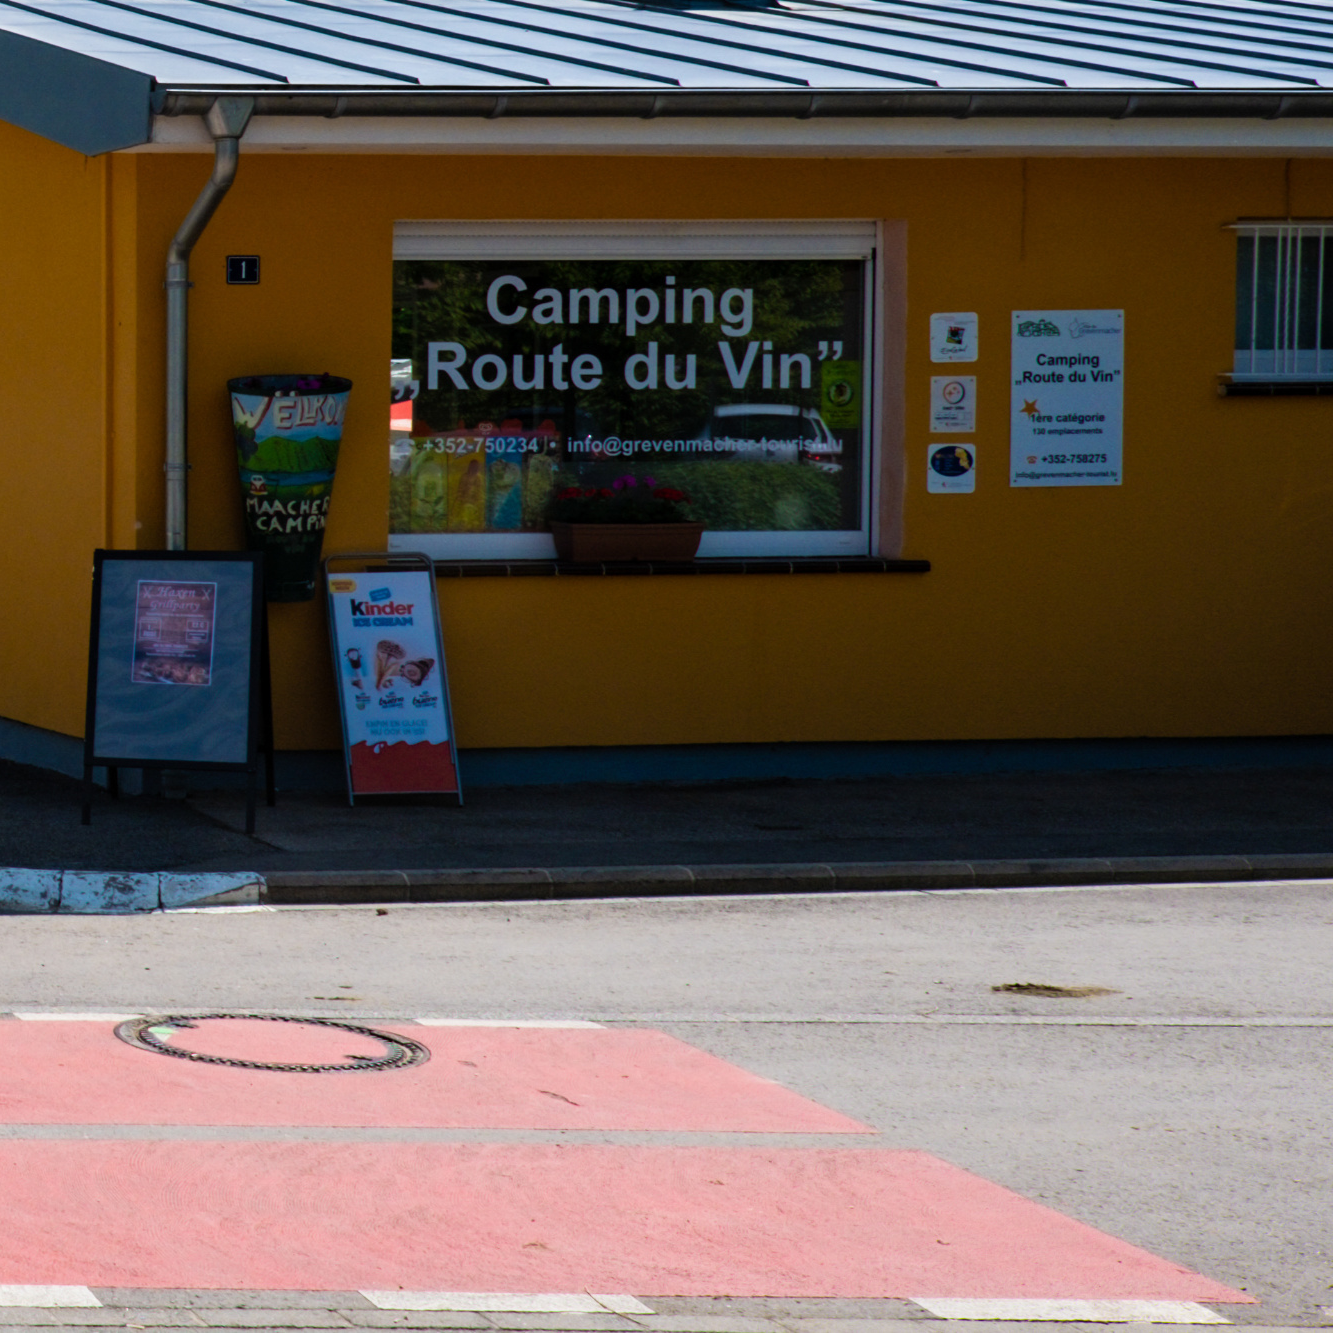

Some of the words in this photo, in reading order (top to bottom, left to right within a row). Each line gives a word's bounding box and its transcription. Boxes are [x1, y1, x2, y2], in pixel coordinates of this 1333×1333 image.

[240, 260, 247, 279] 1
[486, 275, 753, 338] Camping
[623, 341, 697, 391] du
[1036, 353, 1100, 368] Camping
[1068, 370, 1086, 383] du
[1055, 412, 1105, 424] catégorie
[1047, 427, 1103, 436] emplacements
[422, 436, 538, 455] +352-750234
[1041, 453, 1107, 464] +352-758275
[155, 586, 196, 600] Haxen
[150, 599, 201, 612] Grillparty
